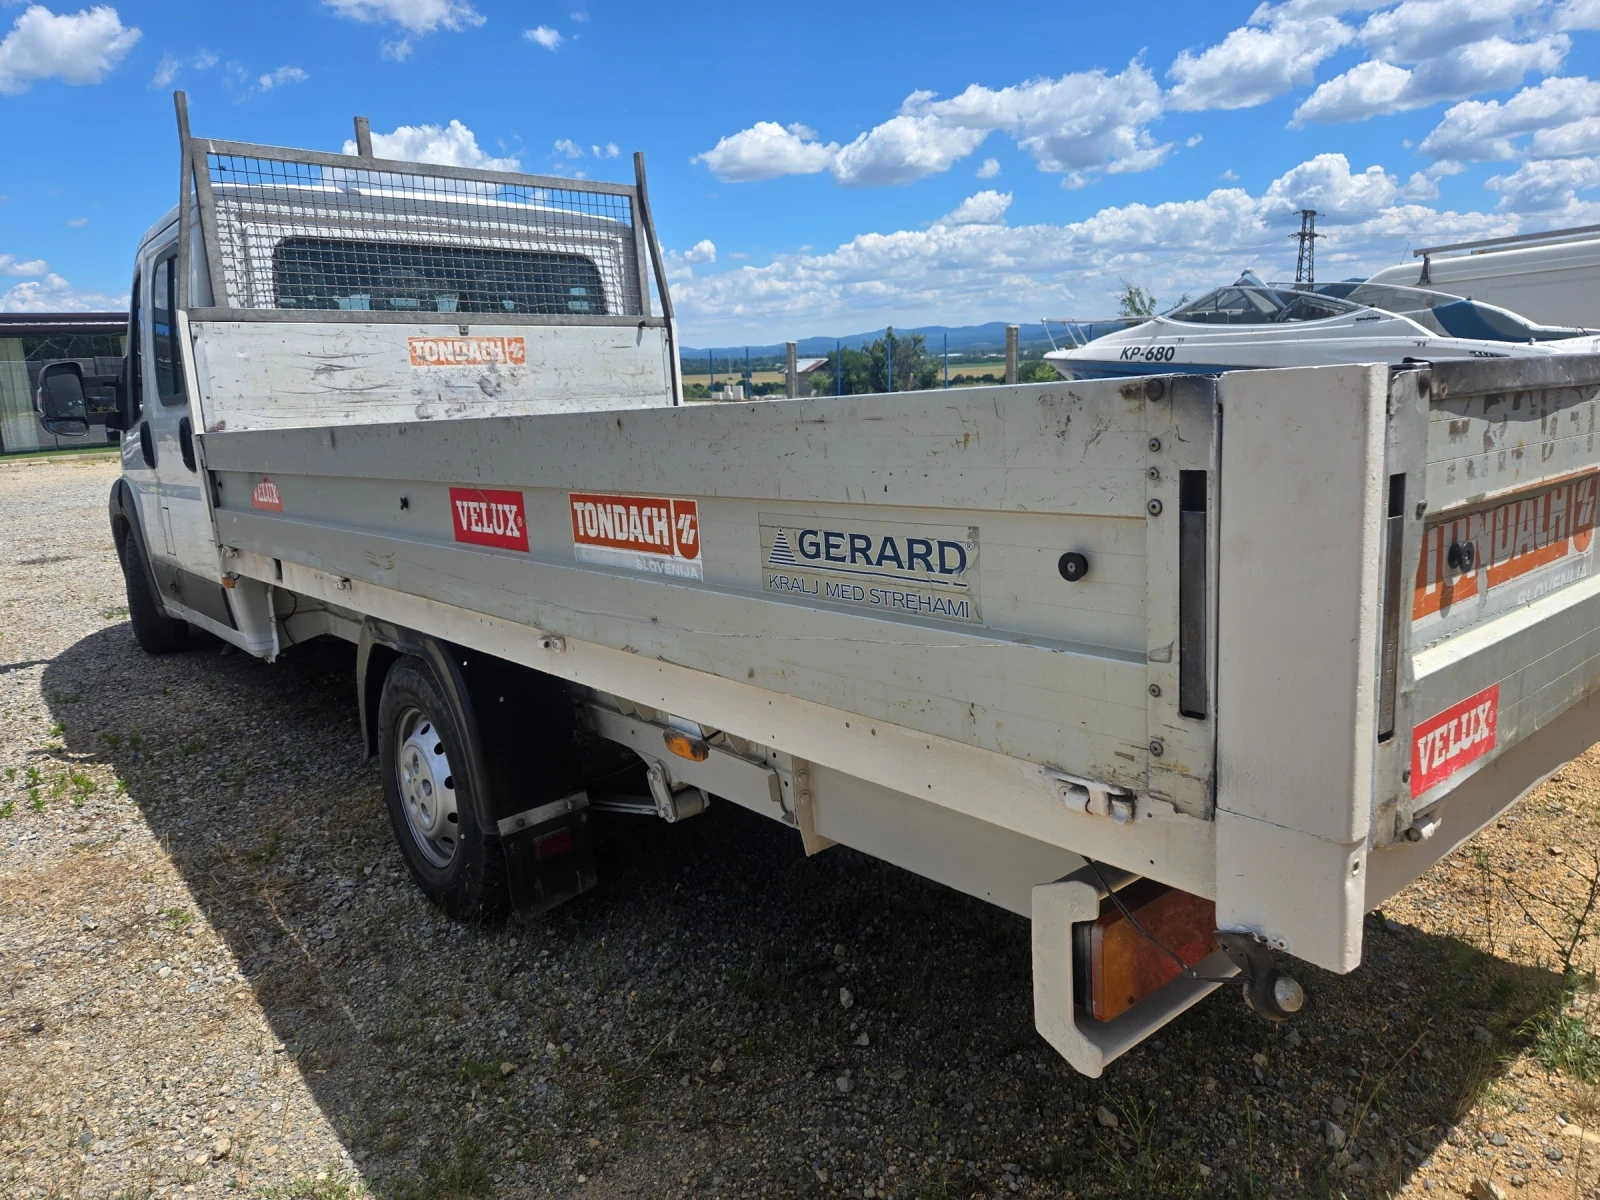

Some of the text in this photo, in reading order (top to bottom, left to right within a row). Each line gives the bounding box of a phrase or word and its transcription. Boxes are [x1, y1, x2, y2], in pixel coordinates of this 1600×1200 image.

[411, 340, 504, 363] TONDACH
[1120, 346, 1175, 361] KP-680
[253, 482, 279, 504] VELUX
[573, 501, 670, 546] TONDACH
[636, 558, 699, 579] SLOVENIJA
[768, 574, 970, 619] KRALJ MED STREHAMI
